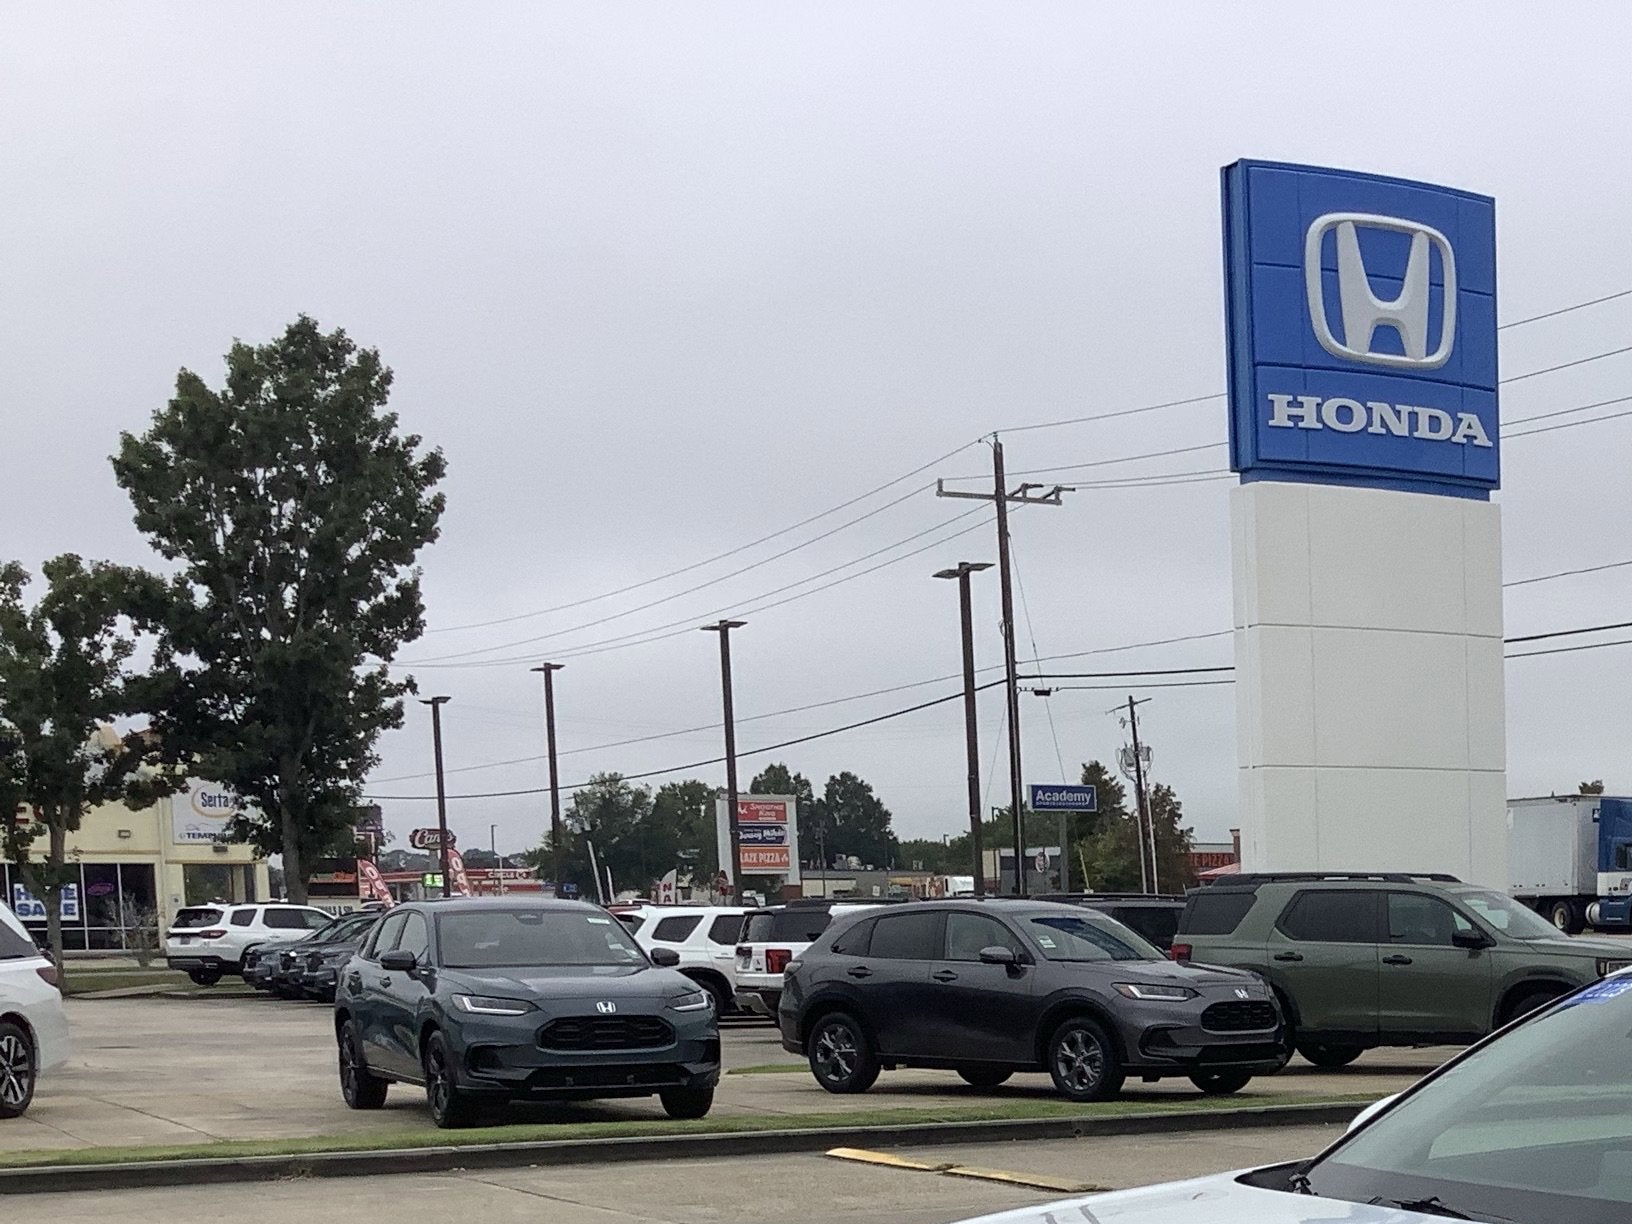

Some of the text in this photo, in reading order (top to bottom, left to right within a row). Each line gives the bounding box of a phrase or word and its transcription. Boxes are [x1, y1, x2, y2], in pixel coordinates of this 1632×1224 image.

[1268, 394, 1493, 447] HONDA
[200, 791, 229, 808] Serta
[1035, 789, 1092, 805] Academy
[758, 852, 781, 863] PIZZA
[17, 903, 77, 916] SAE
